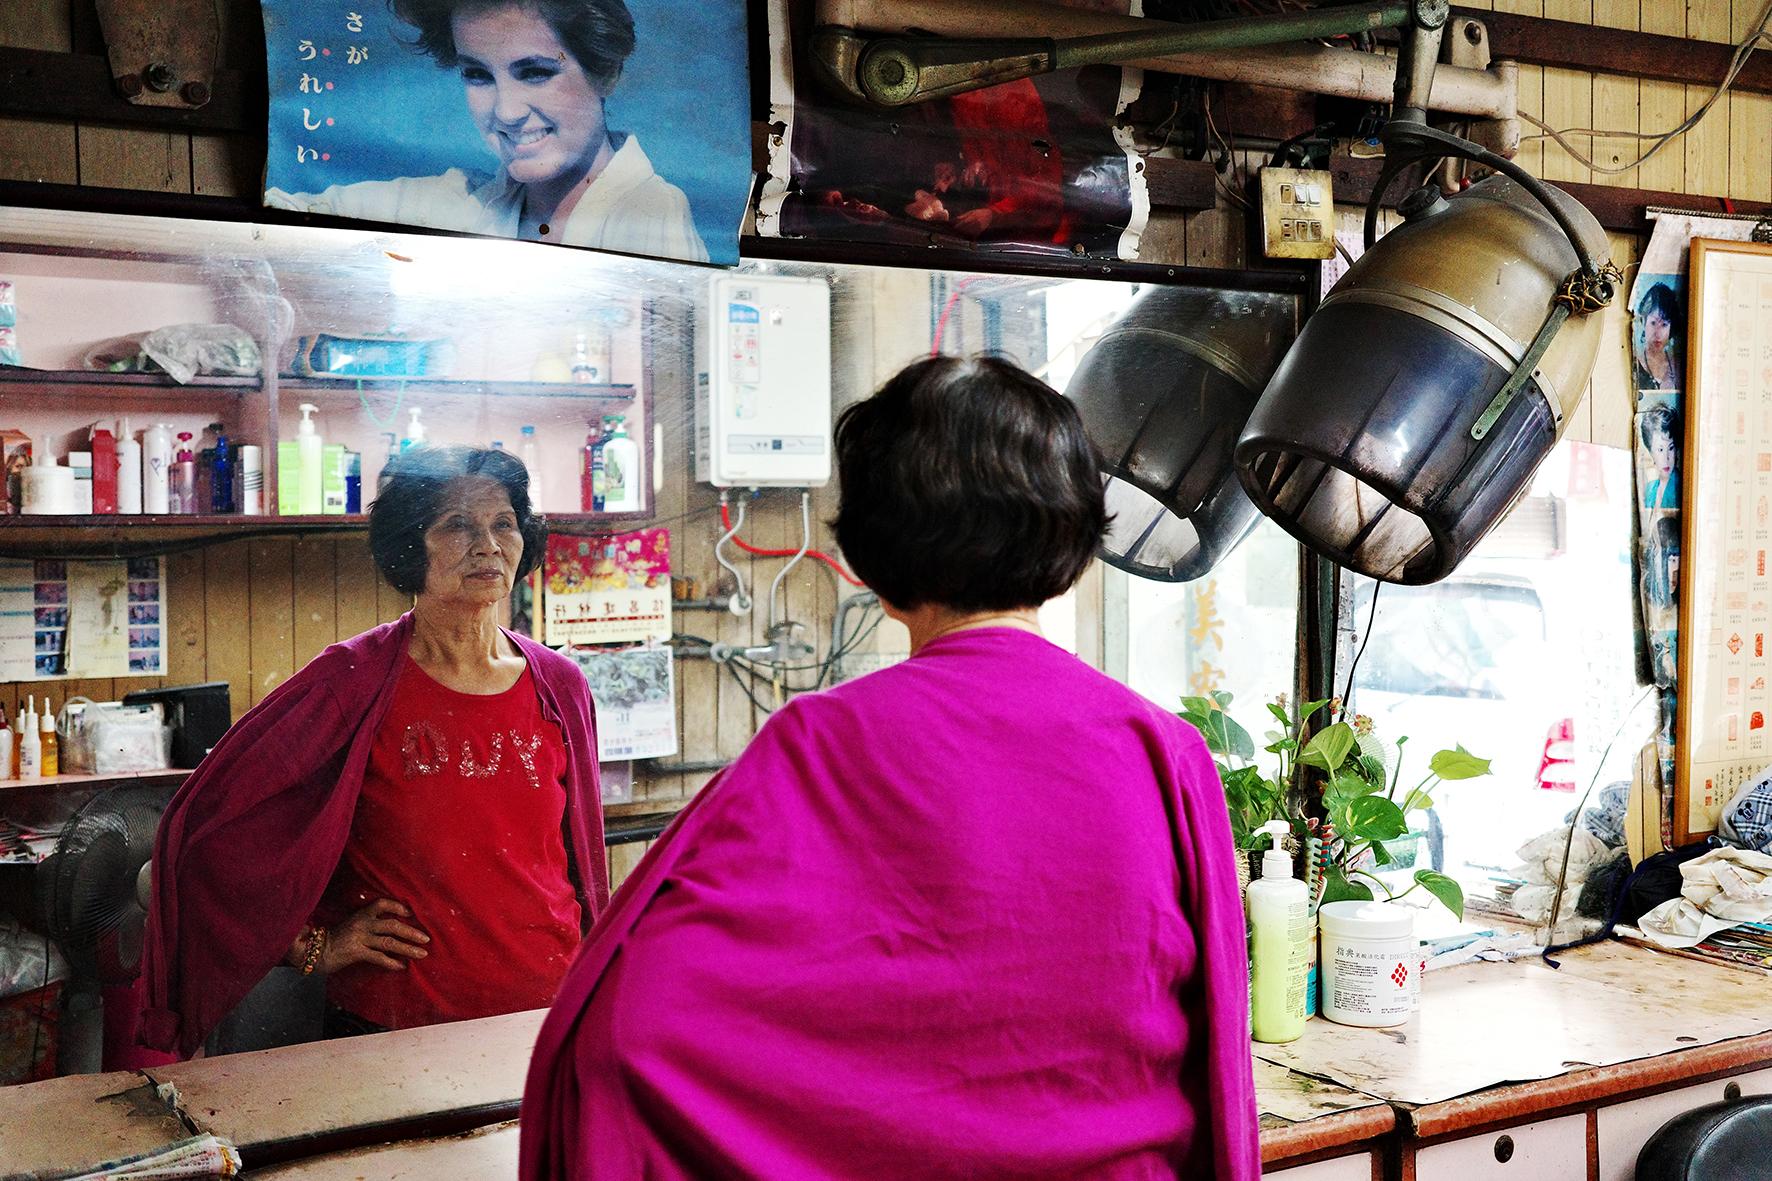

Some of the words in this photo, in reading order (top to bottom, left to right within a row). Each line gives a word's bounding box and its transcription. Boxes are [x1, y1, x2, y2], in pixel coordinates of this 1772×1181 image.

[345, 11, 369, 65] さが
[297, 39, 323, 164] うれしい
